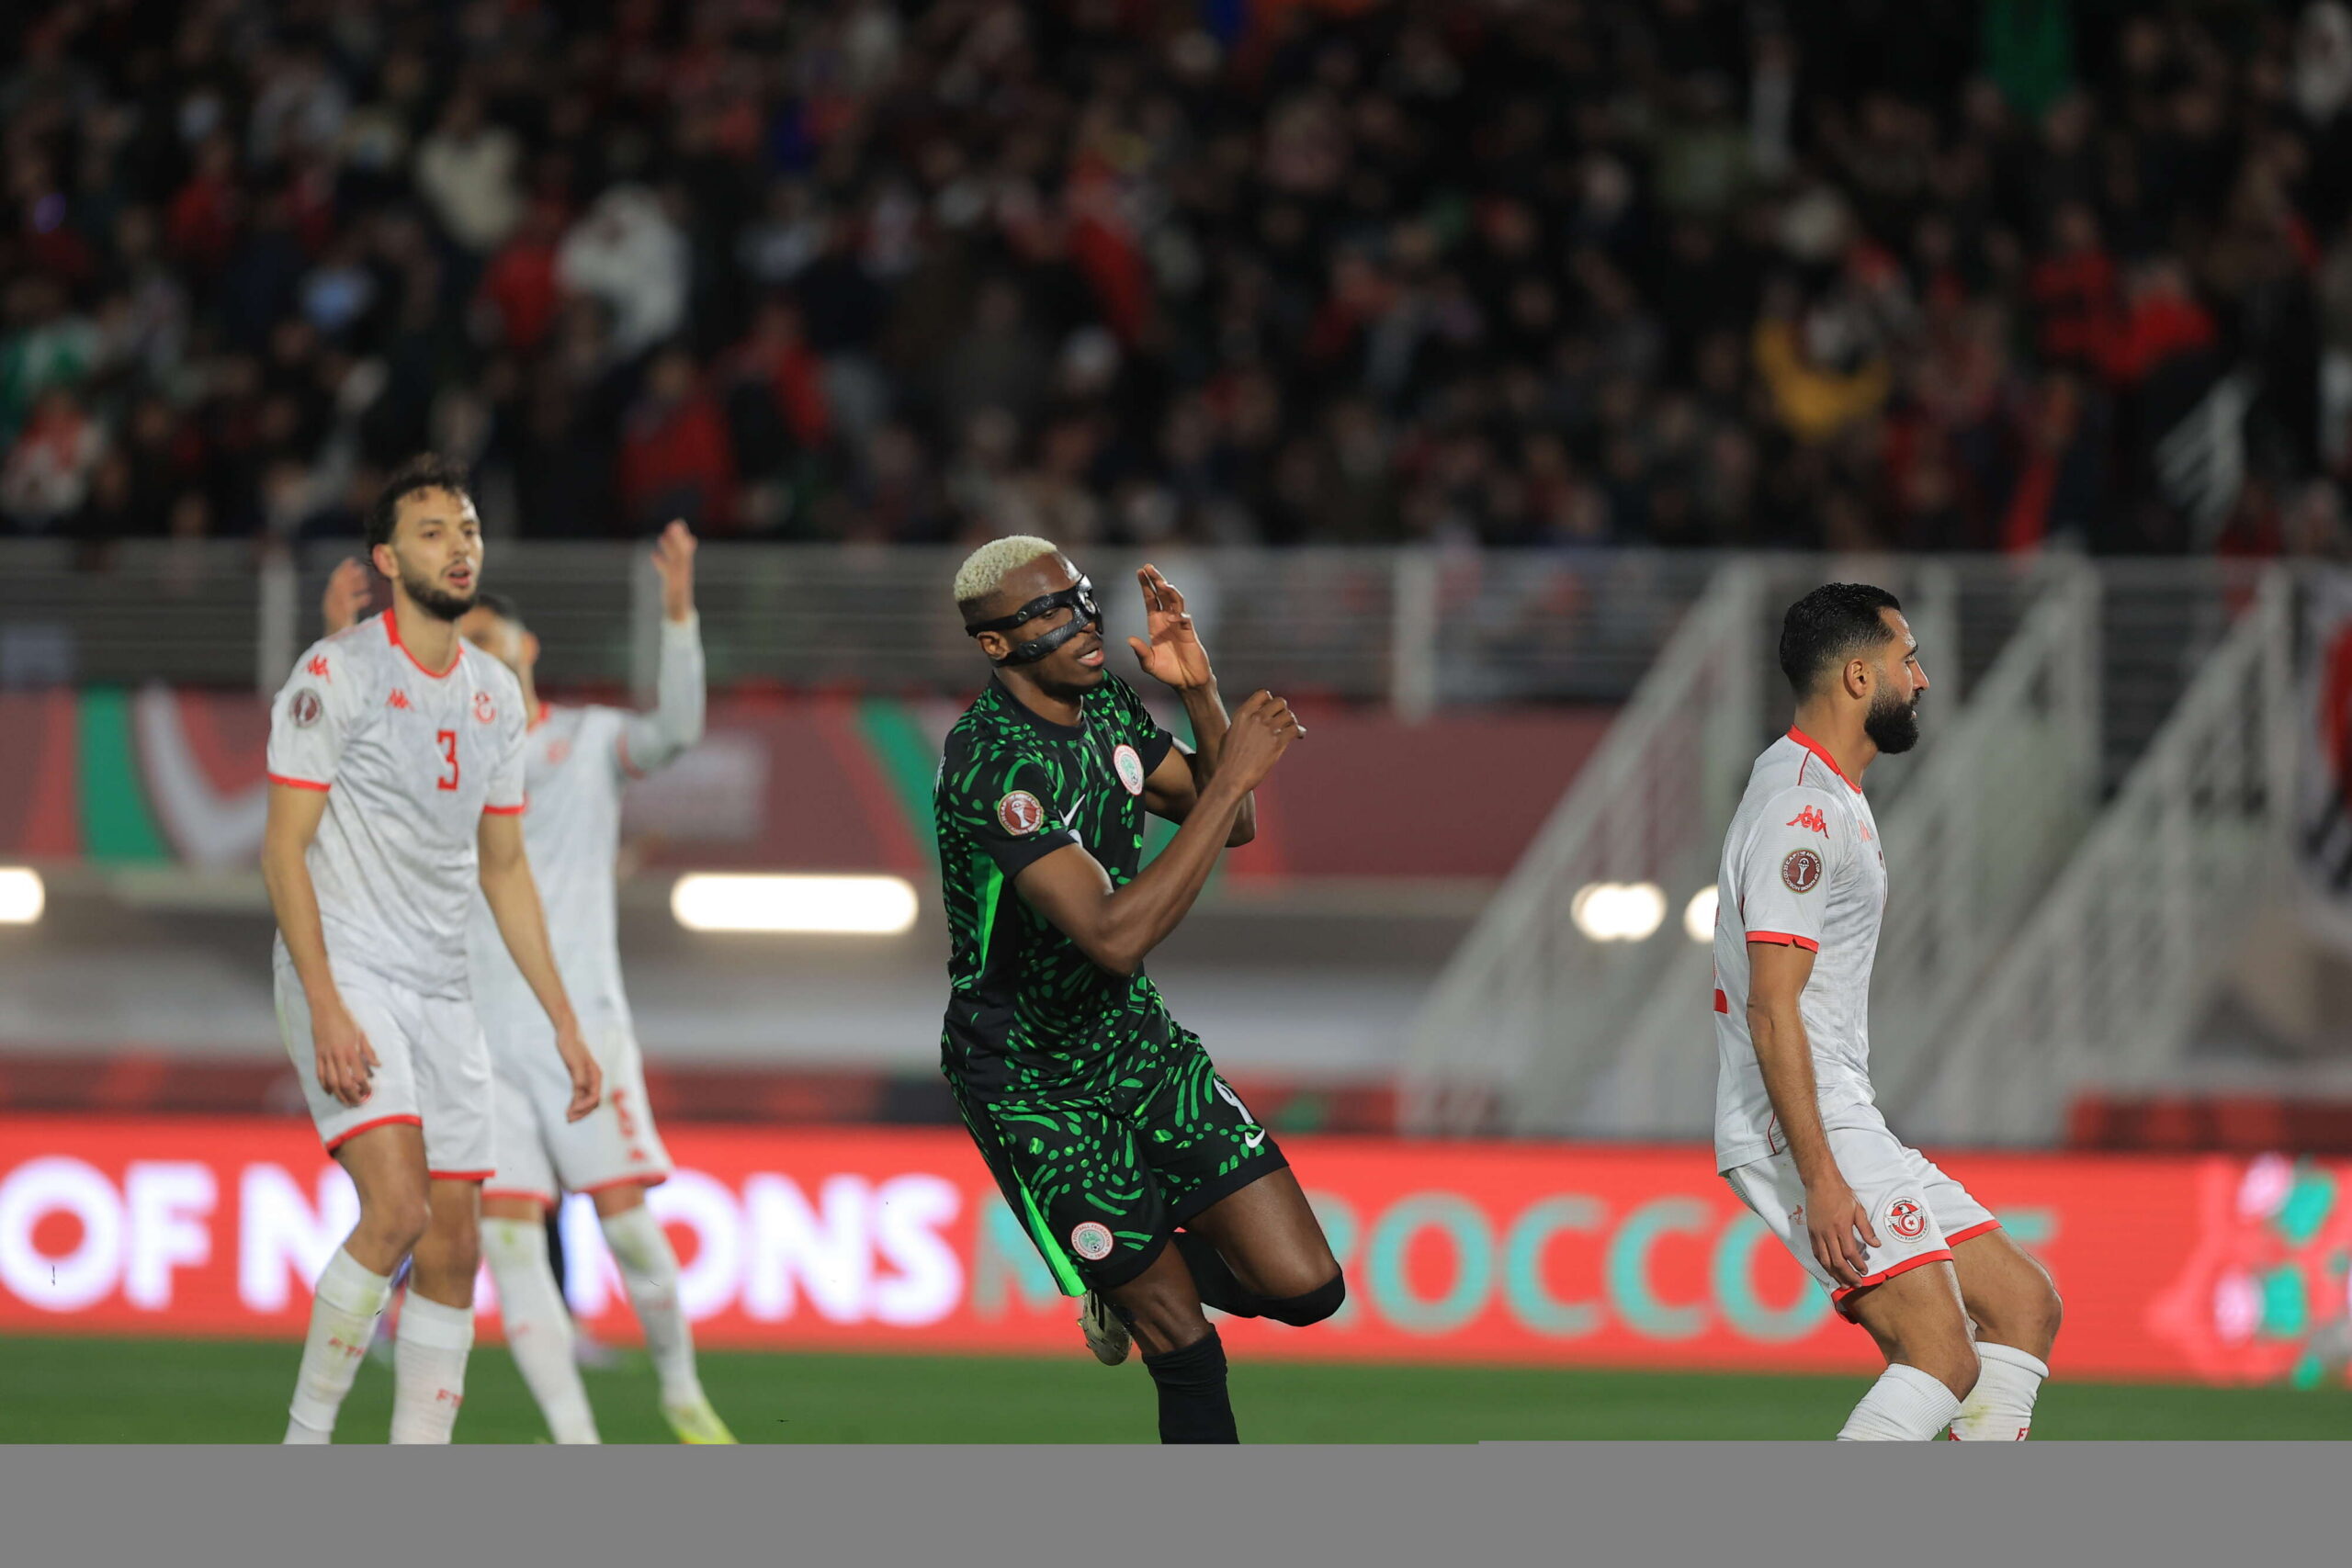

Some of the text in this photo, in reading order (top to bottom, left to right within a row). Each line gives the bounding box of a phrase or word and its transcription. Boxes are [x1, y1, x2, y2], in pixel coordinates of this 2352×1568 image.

[435, 729, 458, 791] 3
[1213, 1077, 1254, 1125] 9
[0, 1155, 1839, 1343] OF NIONS MOCCO
